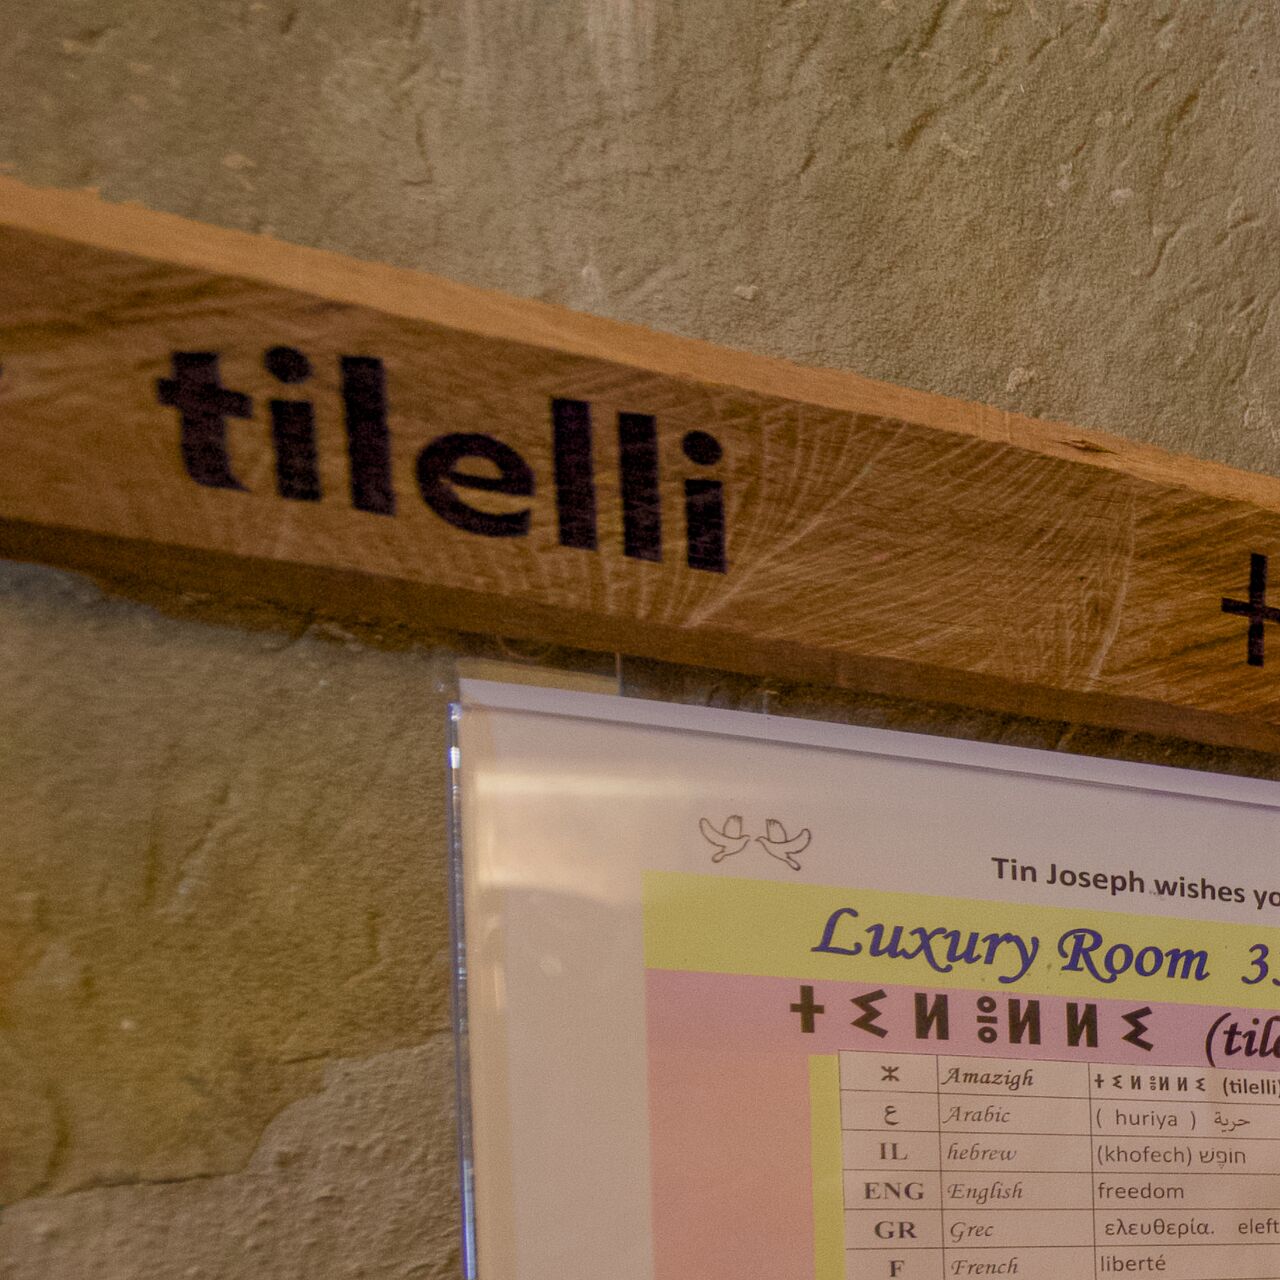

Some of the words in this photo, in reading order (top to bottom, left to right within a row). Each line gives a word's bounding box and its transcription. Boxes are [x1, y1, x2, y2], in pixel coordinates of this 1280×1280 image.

[156, 345, 727, 574] tilelli
[991, 857, 1037, 882] Tin
[1046, 863, 1145, 897] Joseph
[1154, 877, 1245, 903] wishes
[811, 907, 1039, 983] Luxury
[1058, 928, 1209, 984] Room
[941, 1068, 1034, 1090] Amazigh
[942, 1106, 1010, 1124] Arabic
[1214, 1111, 1250, 1132] حرية
[880, 1142, 908, 1160] IL
[947, 1142, 1016, 1161] hebrew
[1098, 1145, 1192, 1166] (khofech)
[864, 1182, 924, 1199] ENG
[947, 1182, 1023, 1204] English
[1098, 1181, 1184, 1199] freedom
[875, 1221, 918, 1239] GR
[950, 1222, 993, 1242] Grec
[889, 1260, 905, 1277] F
[951, 1257, 1018, 1275] French
[1100, 1254, 1166, 1272] liberté
